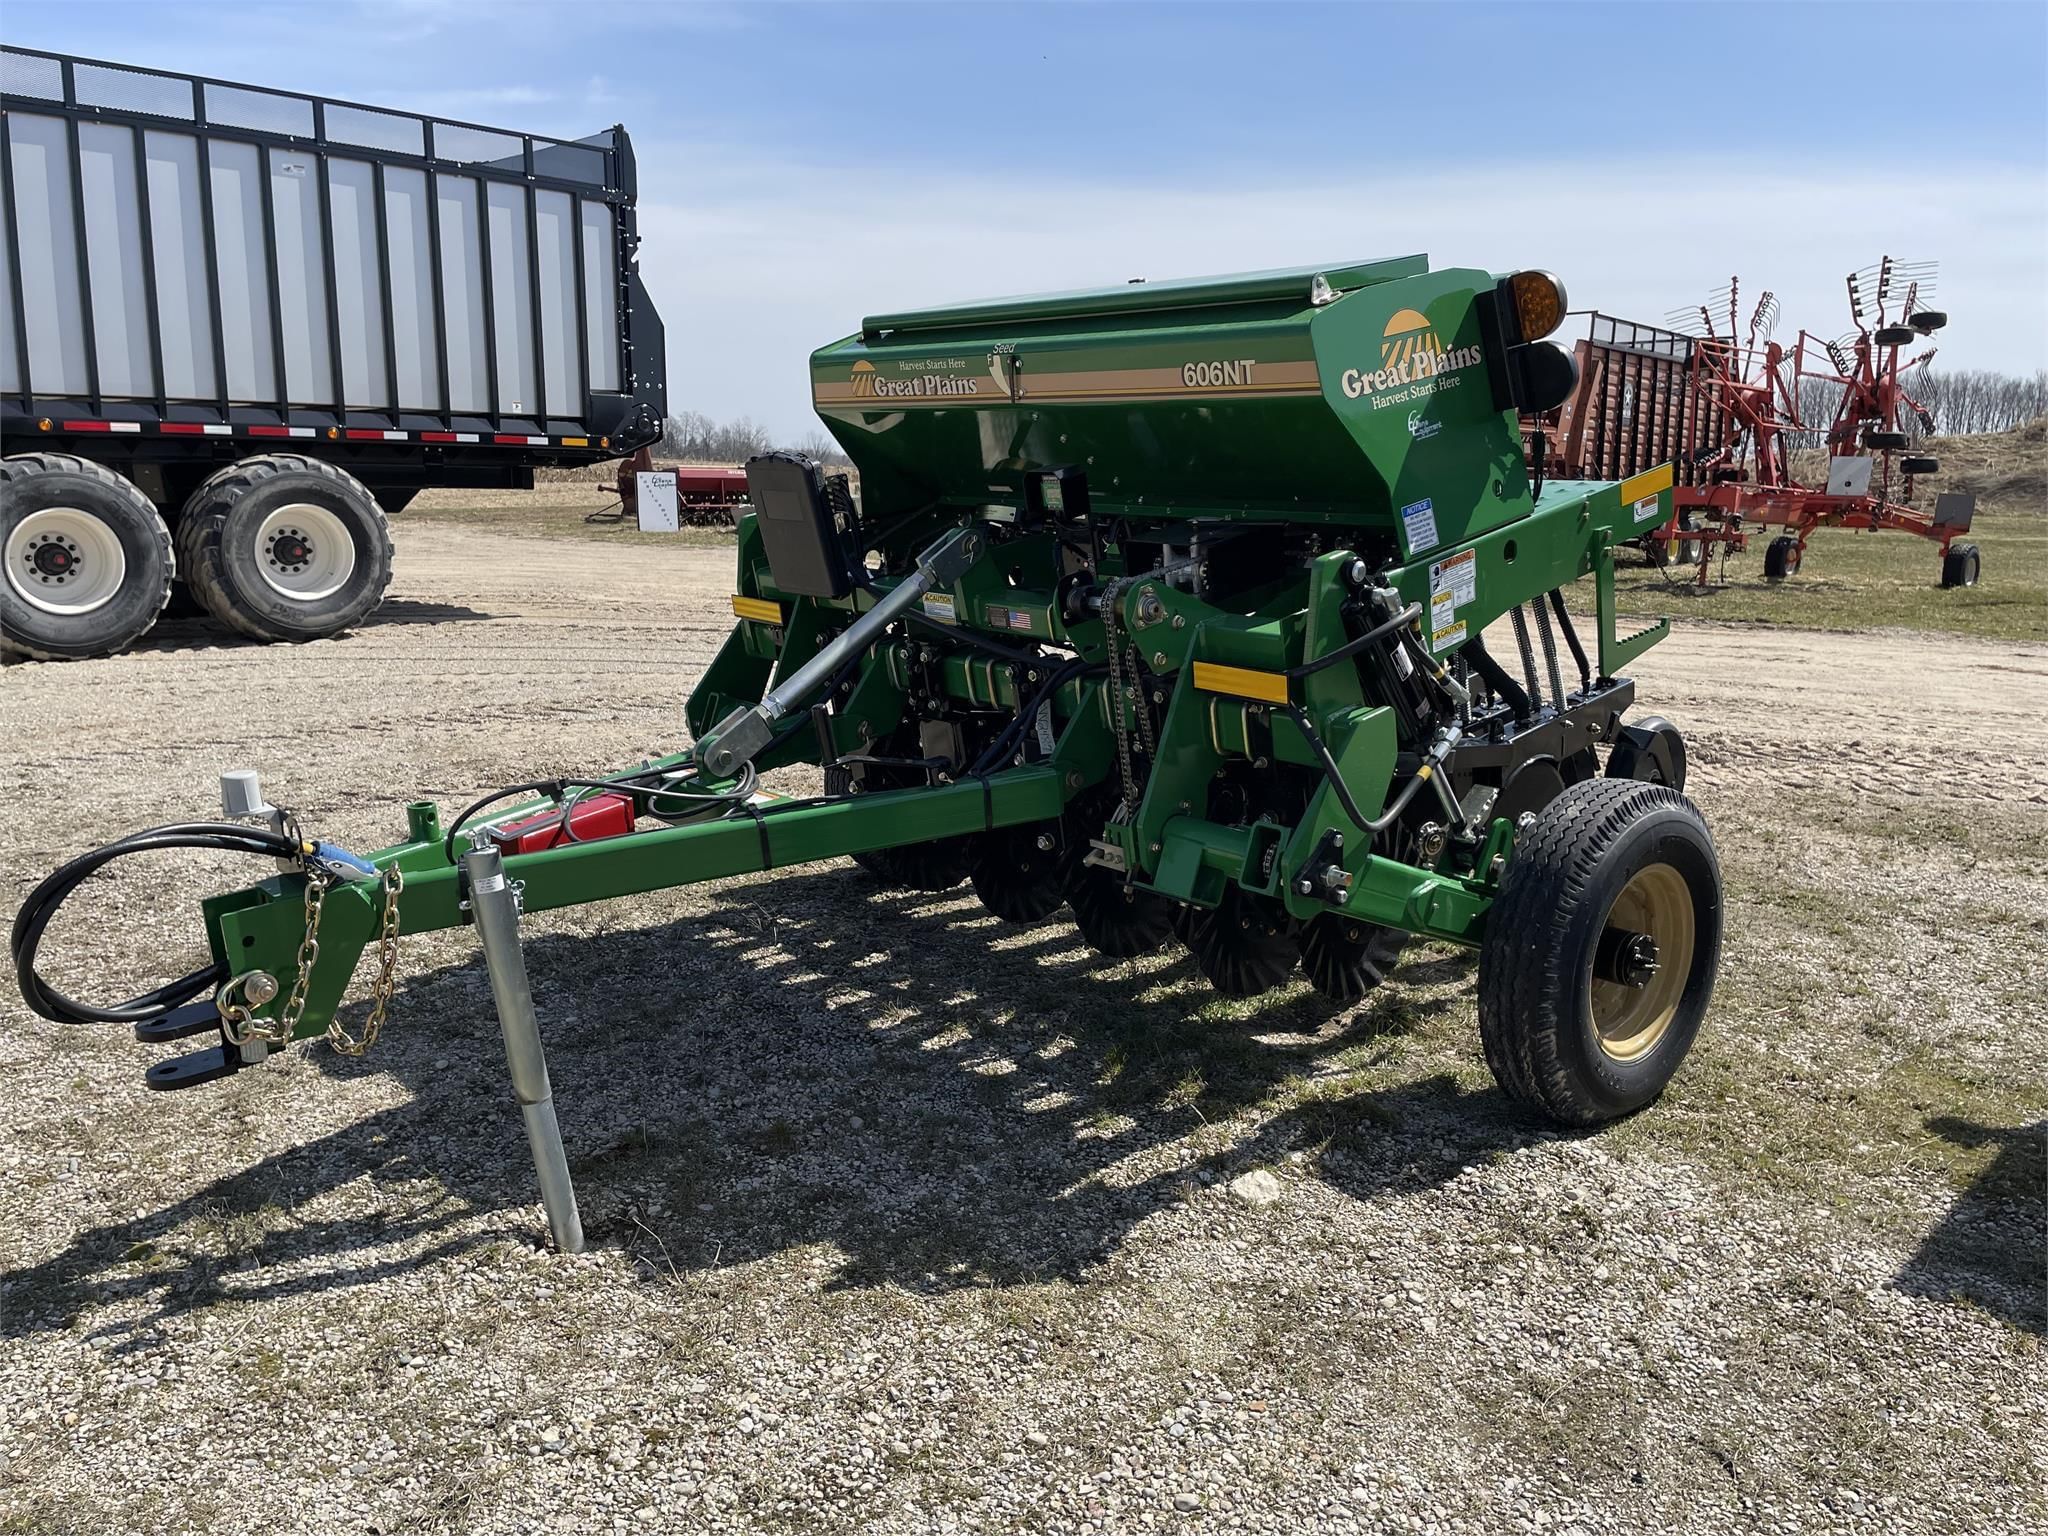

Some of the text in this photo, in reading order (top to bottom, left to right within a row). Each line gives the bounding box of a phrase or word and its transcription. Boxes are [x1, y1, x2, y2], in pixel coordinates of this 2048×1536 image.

[992, 343, 1015, 353] Seed
[899, 358, 966, 371] Harvest Starts Here
[1183, 359, 1256, 387] 606NT
[1341, 344, 1482, 399] Great Plains
[874, 374, 978, 397] Great Plains
[1371, 375, 1461, 410] Harvest Starts Here
[1406, 501, 1429, 515] NOTICE
[1440, 622, 1464, 637] CAUTION
